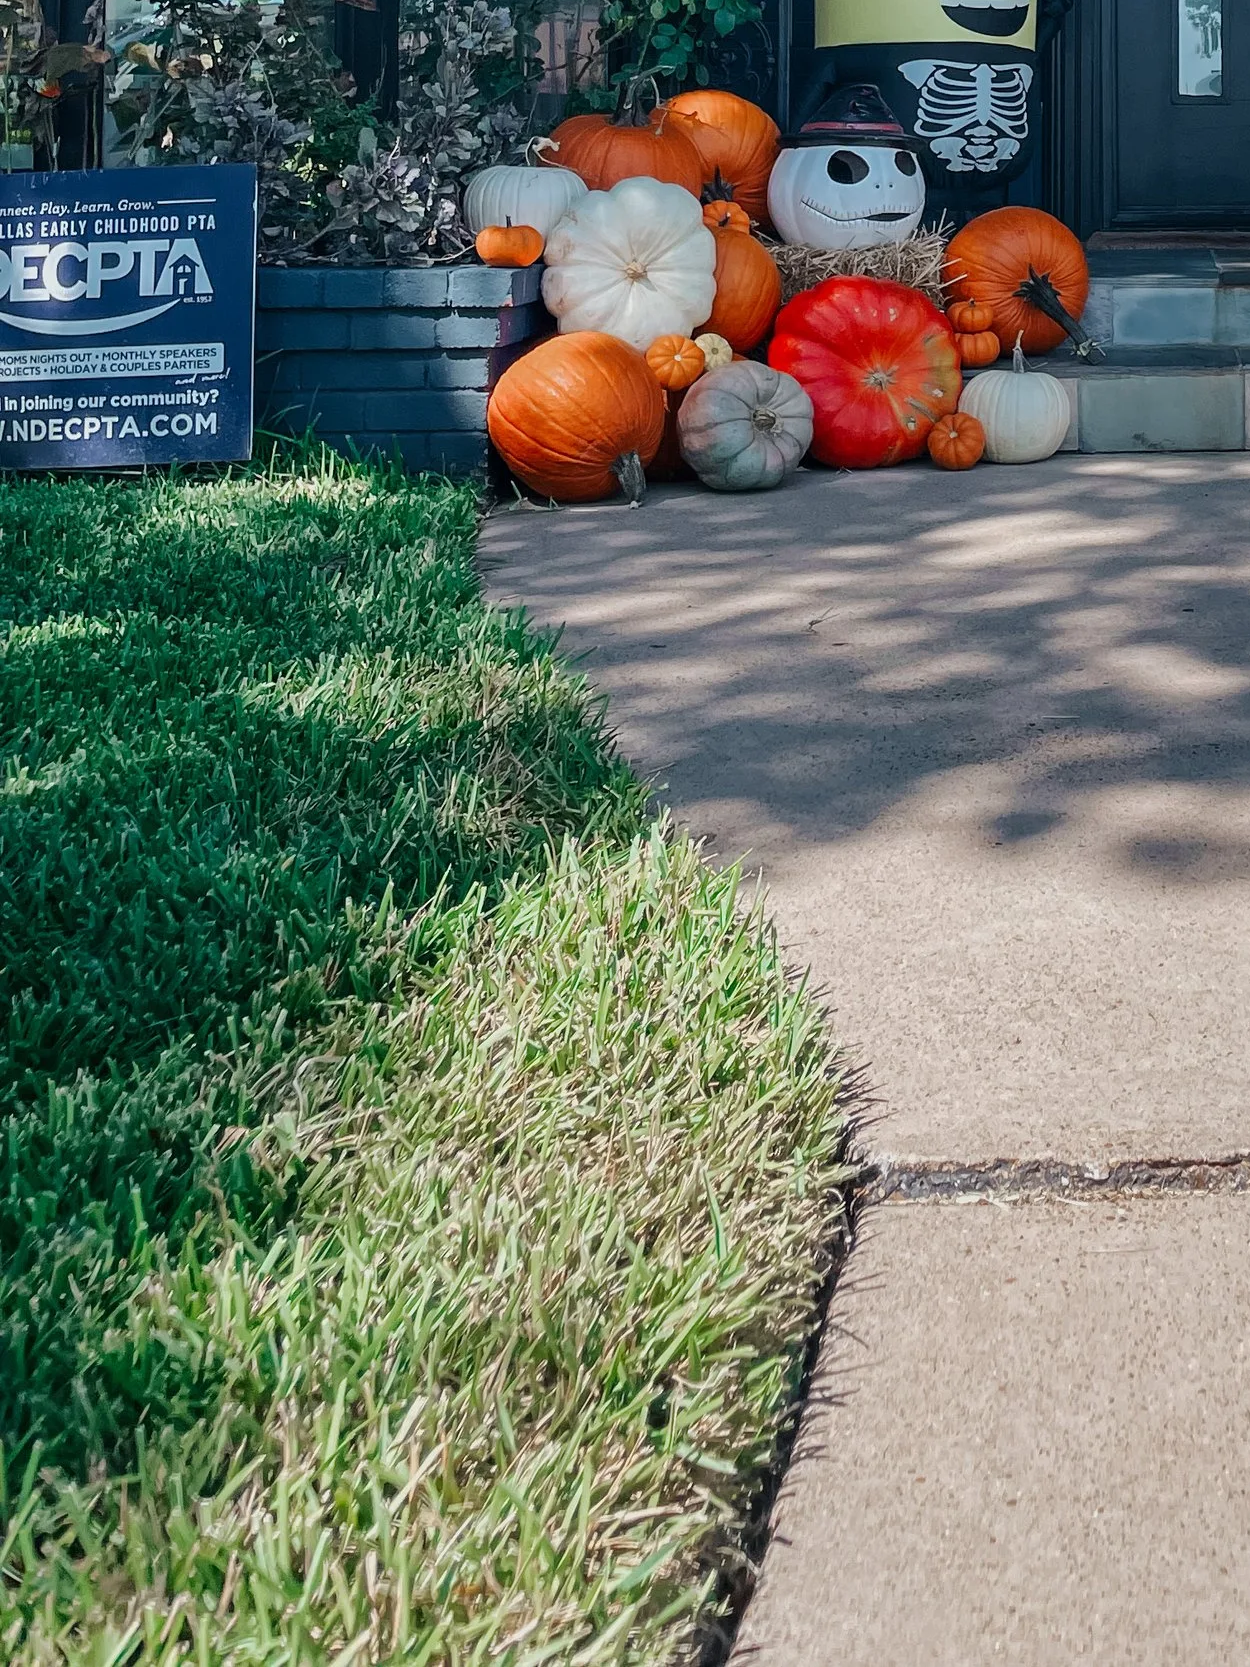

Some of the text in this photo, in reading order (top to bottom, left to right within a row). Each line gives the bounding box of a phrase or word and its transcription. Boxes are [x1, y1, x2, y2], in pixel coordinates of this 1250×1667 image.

[40, 201, 70, 216] Play.
[73, 201, 114, 213] Learn.
[118, 199, 154, 211] Grow.
[40, 220, 87, 237] EARLY
[94, 216, 179, 235] CHILDHOOD
[187, 214, 216, 231] PTA
[30, 353, 67, 364] NIGHTS
[70, 352, 92, 362] OUT
[102, 350, 157, 361] MONTHLY
[159, 348, 217, 359] SPEAKERS
[50, 364, 97, 374] HOLIDAY
[100, 363, 107, 372] &
[110, 361, 161, 372] COUPLES
[164, 360, 210, 370] PARTIES
[175, 373, 198, 385] and
[4, 396, 18, 411] in
[20, 395, 73, 413] joining
[77, 396, 107, 409] our
[110, 389, 219, 407] community?
[0, 412, 217, 442] .NDECPTA.COM
